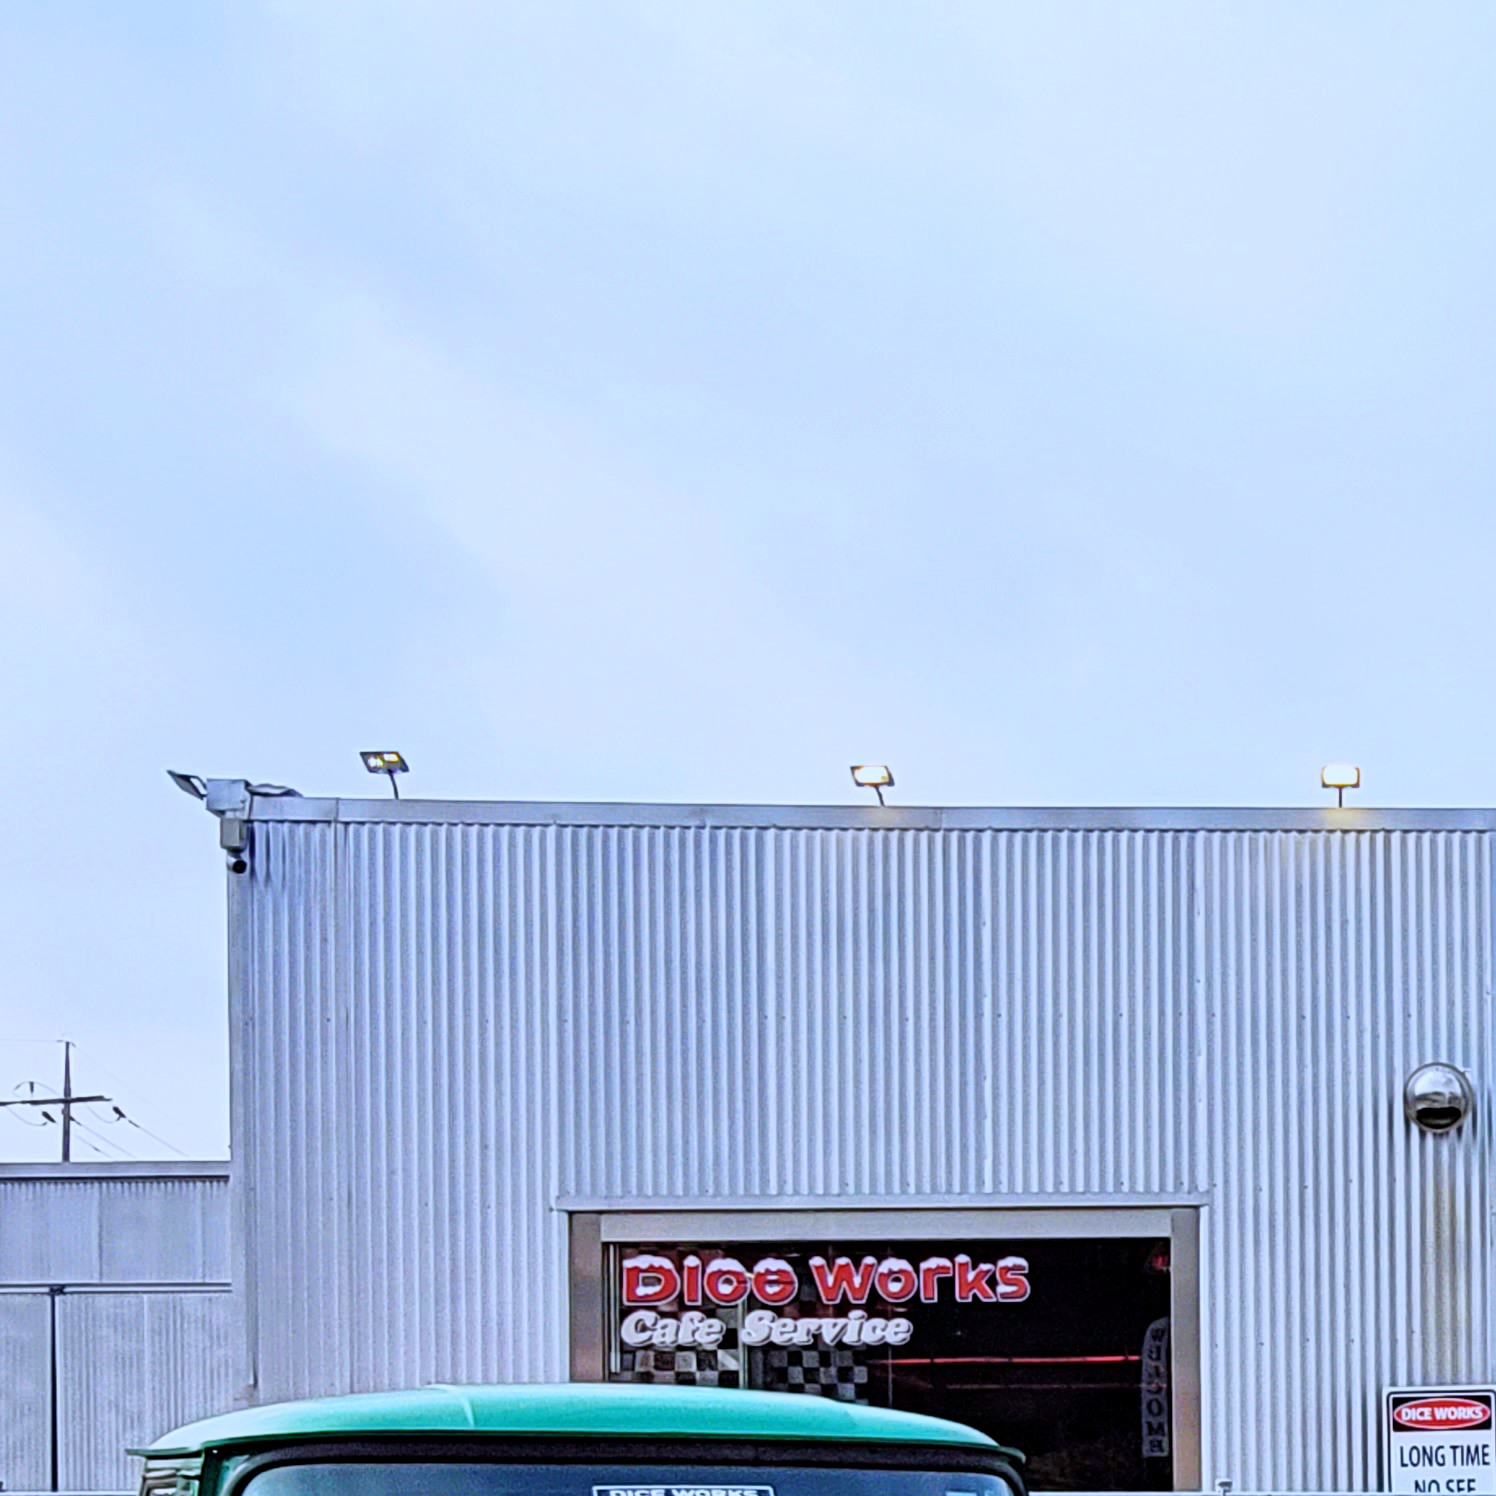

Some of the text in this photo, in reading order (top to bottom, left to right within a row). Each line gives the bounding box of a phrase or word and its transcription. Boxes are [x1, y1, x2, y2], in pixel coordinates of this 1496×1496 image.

[808, 1253, 1031, 1305] Works
[620, 1309, 914, 1347] Cafe Service
[1401, 1405, 1484, 1421] DICE WORKS
[1400, 1444, 1491, 1468] LONG TIME
[1414, 1479, 1441, 1493] NO
